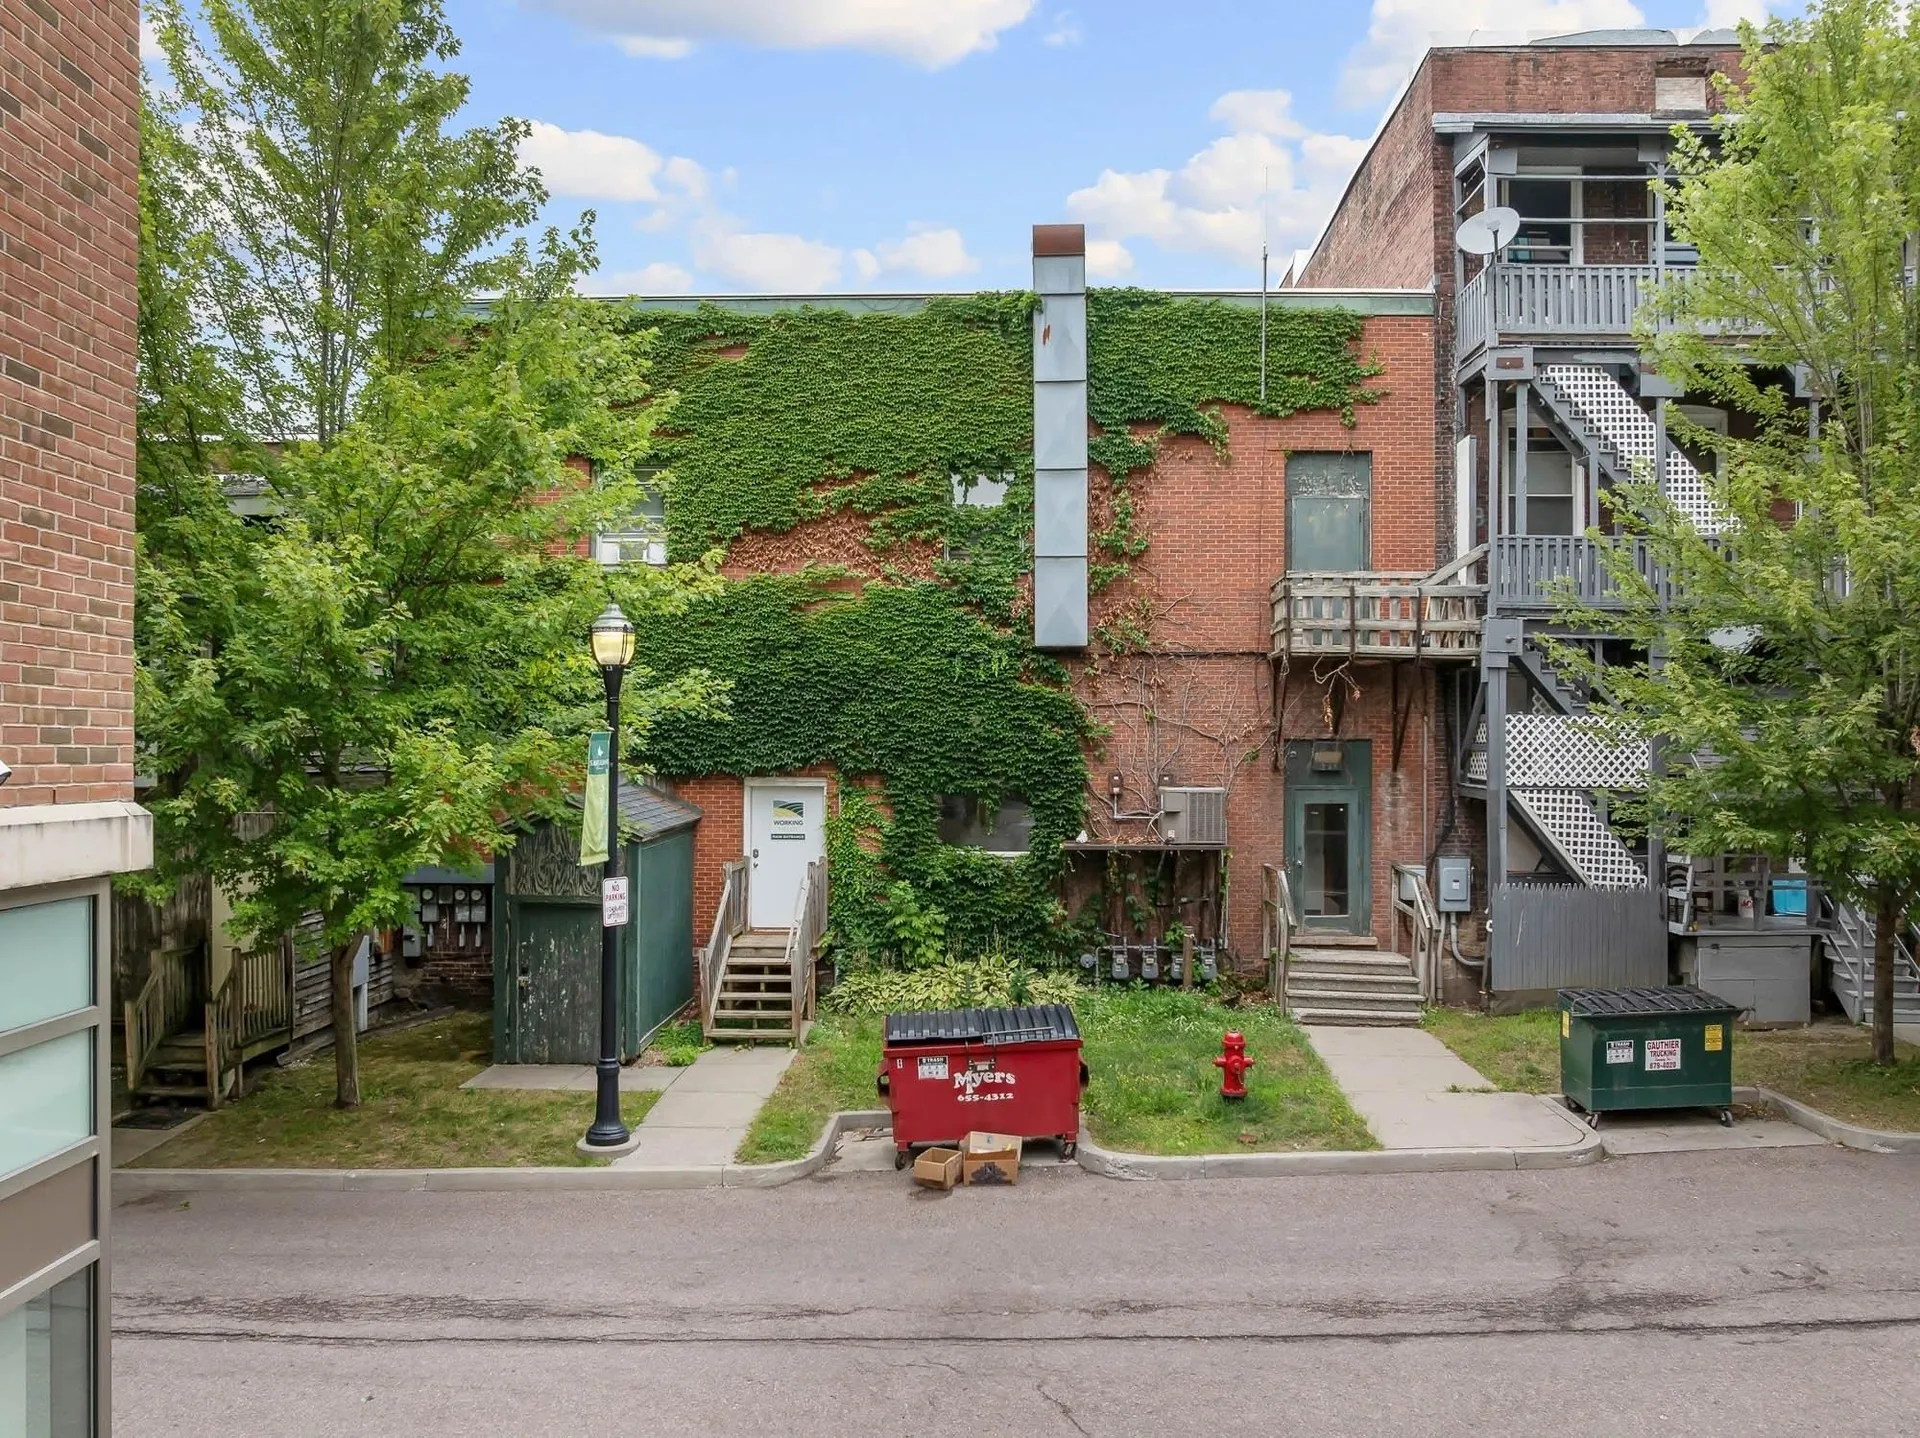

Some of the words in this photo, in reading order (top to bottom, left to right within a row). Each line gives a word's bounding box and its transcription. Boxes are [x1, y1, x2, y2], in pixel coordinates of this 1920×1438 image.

[612, 884, 620, 892] NO
[605, 893, 626, 901] PARKING
[1646, 1040, 1680, 1051] GAUTHIER
[1649, 1049, 1677, 1058] TRUCKING
[953, 1070, 1016, 1095] Myers
[957, 1092, 1015, 1102] 655-4312
